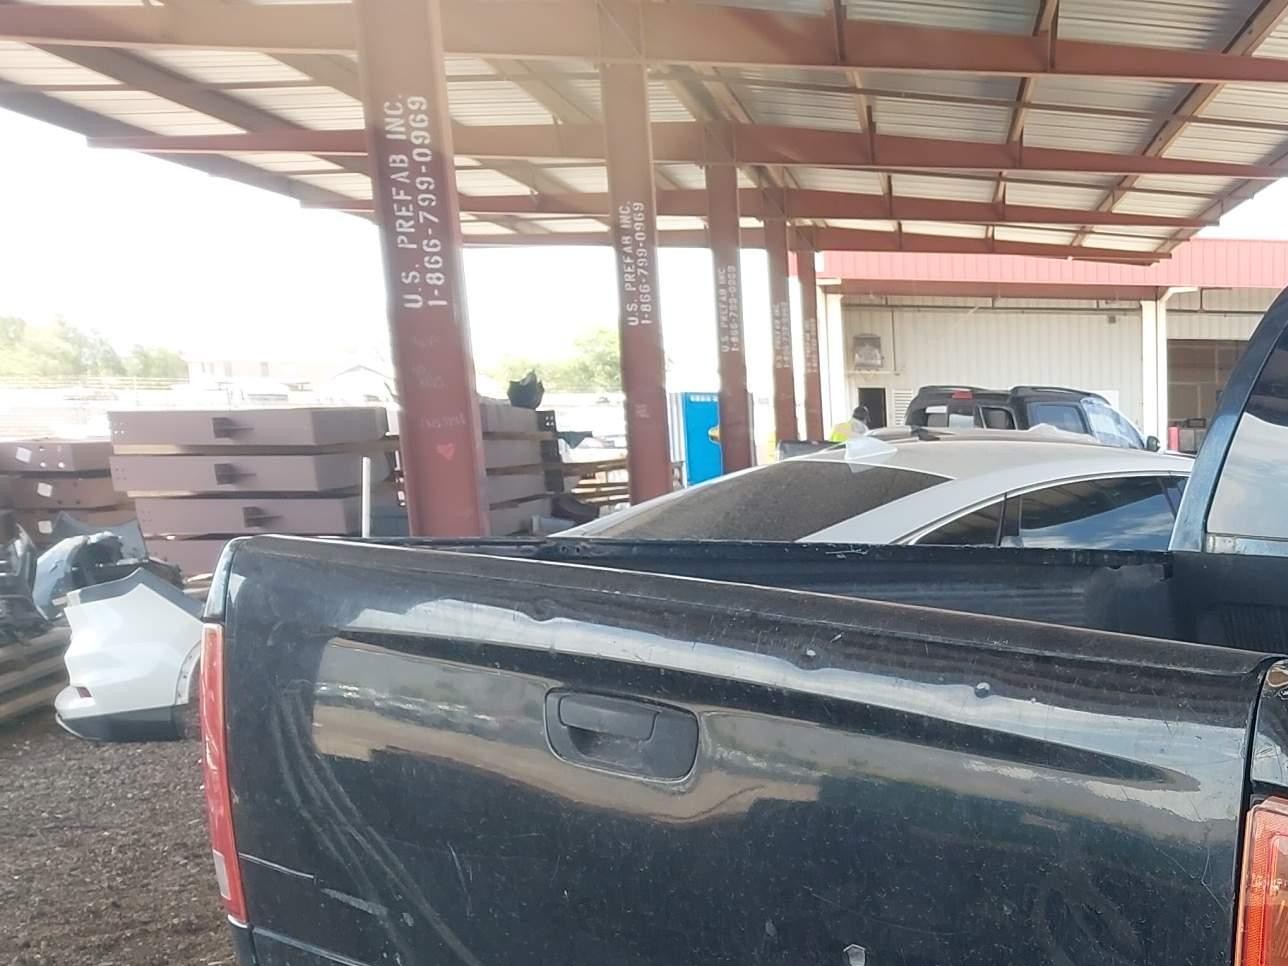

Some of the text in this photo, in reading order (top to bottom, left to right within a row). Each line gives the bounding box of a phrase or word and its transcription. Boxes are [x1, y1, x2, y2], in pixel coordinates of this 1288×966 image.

[389, 153, 418, 250] PREFAB
[407, 96, 448, 306] 1-866-799-0969
[401, 263, 424, 309] U.S.
[621, 235, 637, 292] PREFAB
[632, 201, 653, 325] 1-866-799-0969
[626, 298, 640, 327] U.S.
